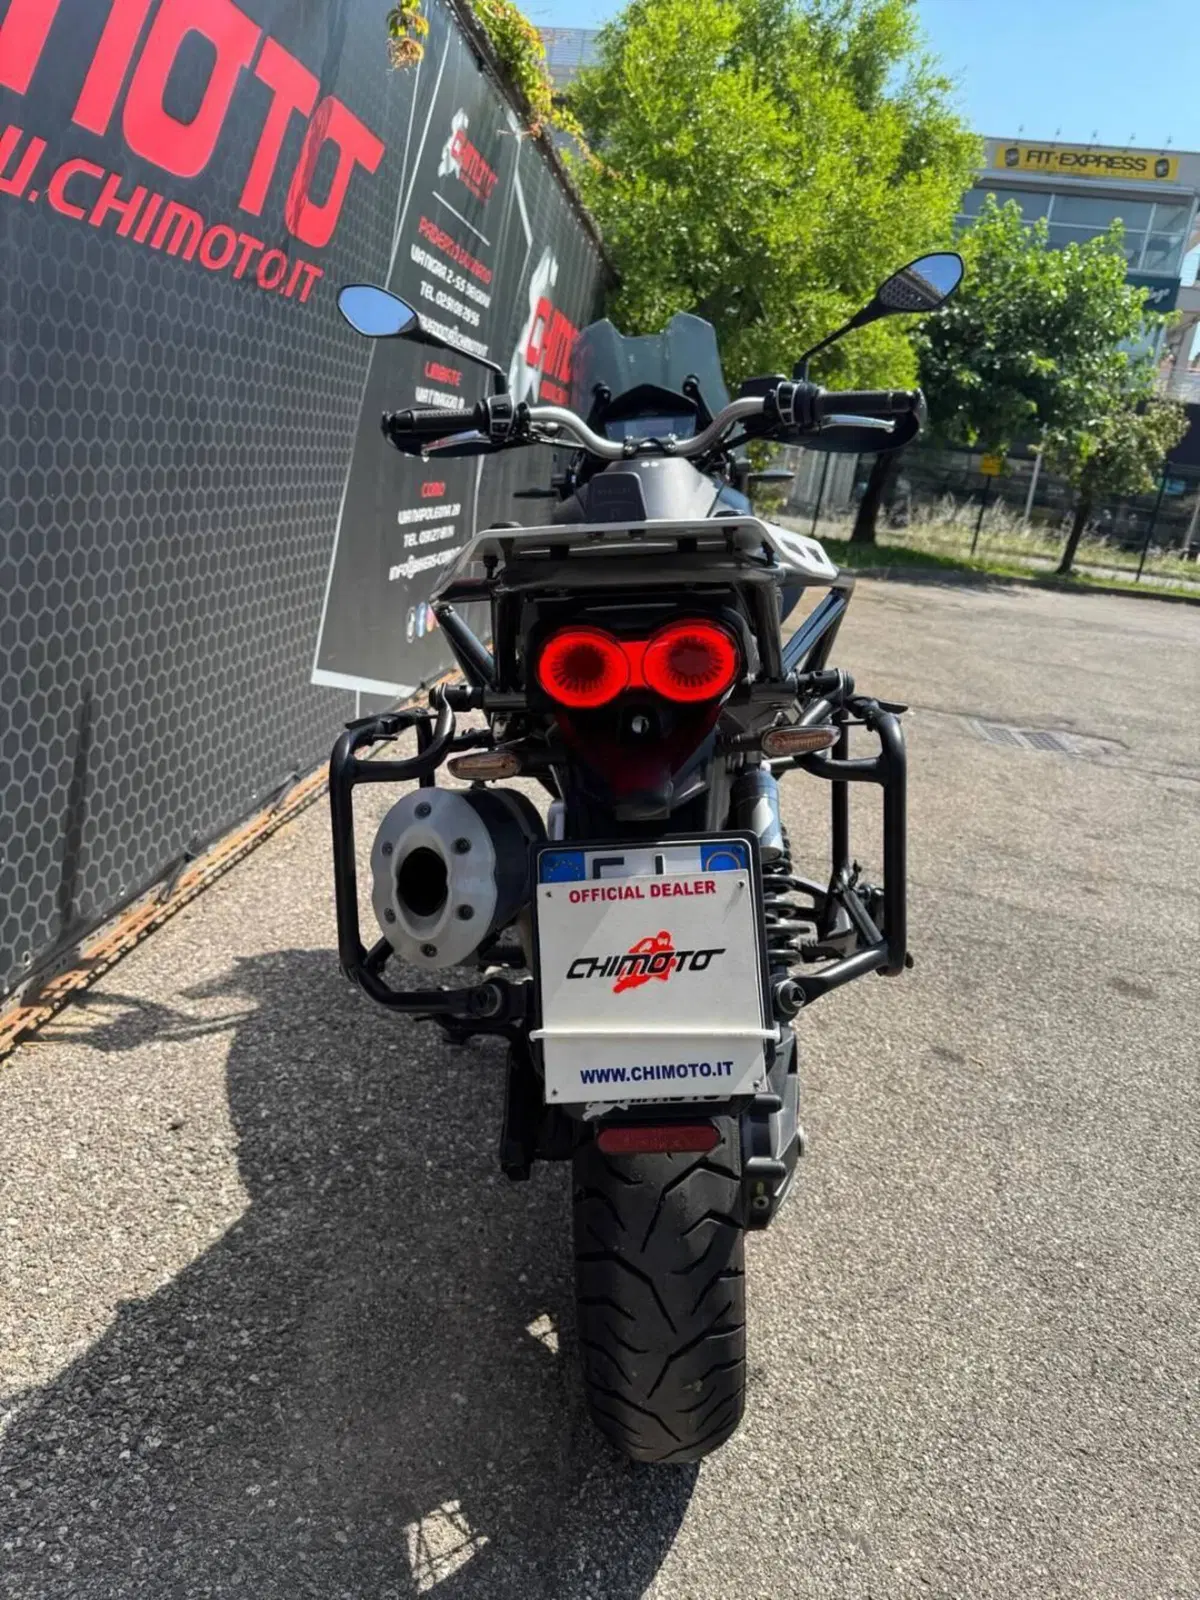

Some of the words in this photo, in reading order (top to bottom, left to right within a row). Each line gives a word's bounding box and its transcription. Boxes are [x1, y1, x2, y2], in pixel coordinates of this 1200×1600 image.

[568, 886, 645, 904] OFFICIAL
[649, 880, 717, 899] DEALER
[565, 947, 727, 980] CHIMOTO
[580, 1060, 734, 1085] WWW.CHIMOTO.IT
